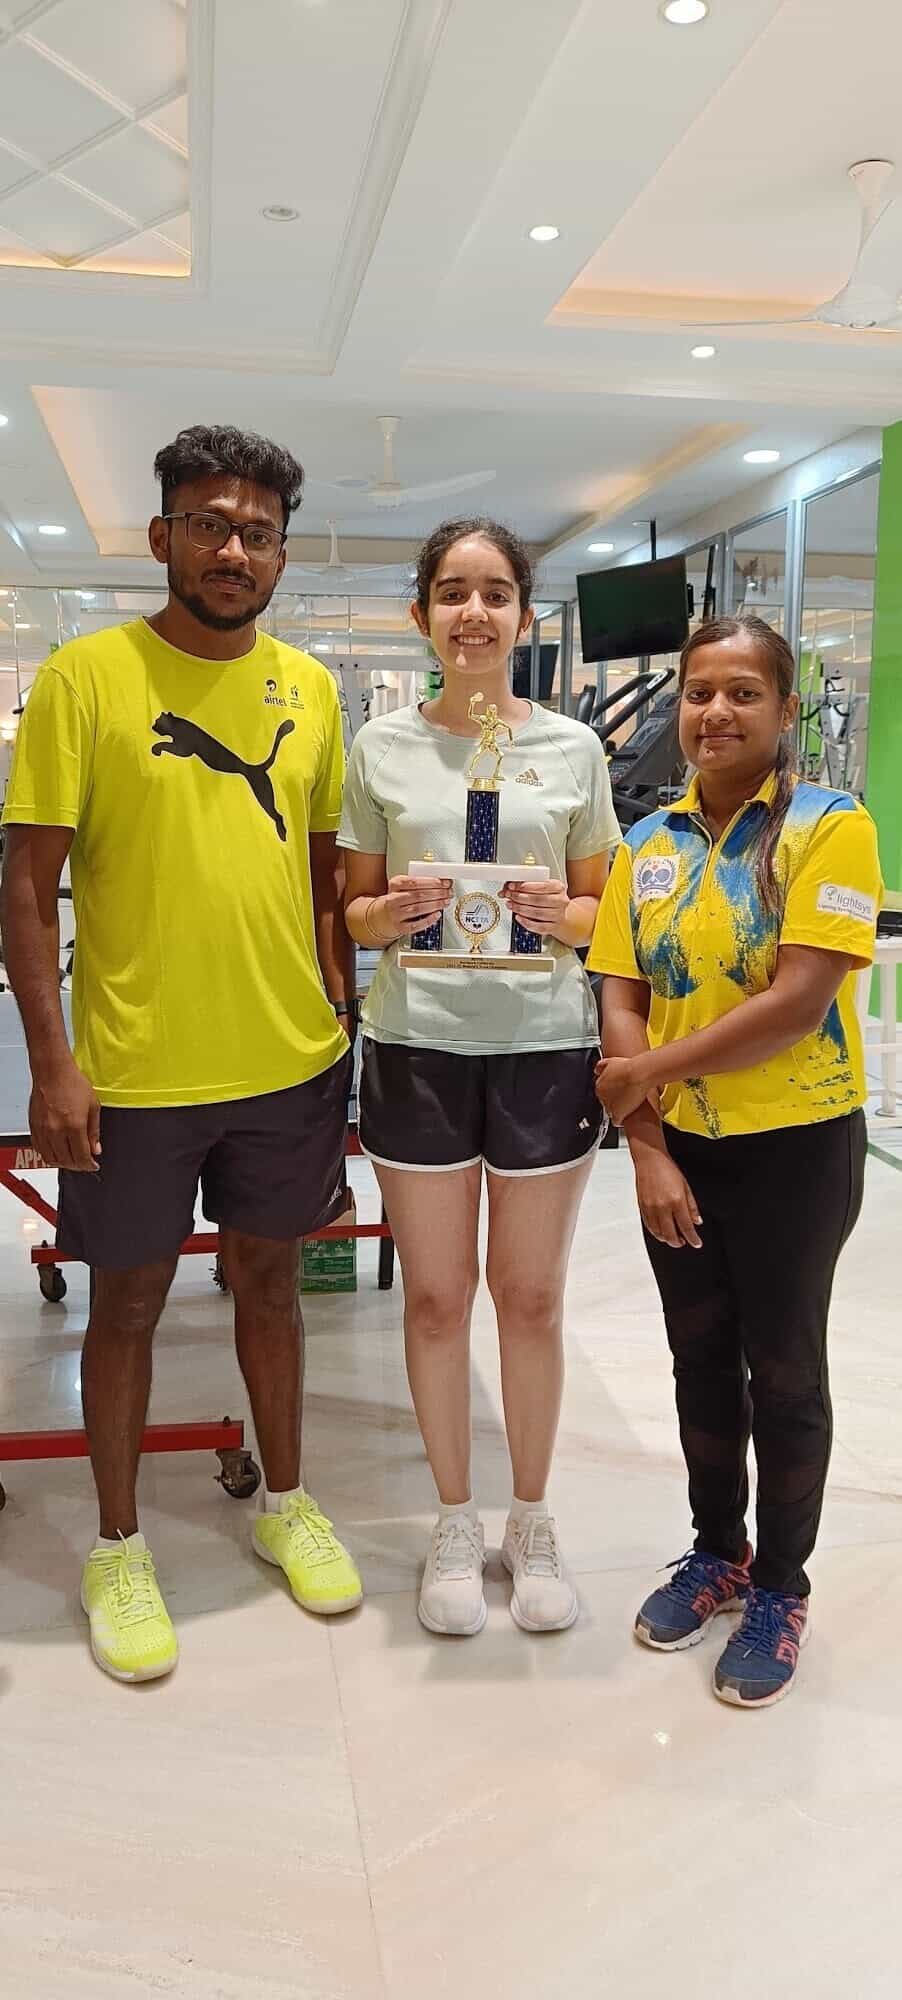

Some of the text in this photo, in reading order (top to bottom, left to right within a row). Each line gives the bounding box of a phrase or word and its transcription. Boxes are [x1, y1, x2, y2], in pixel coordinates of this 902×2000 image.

[264, 694, 287, 706] airtel
[515, 777, 544, 787] adidas
[836, 894, 872, 914] lightsys
[15, 1149, 50, 1168] APP
